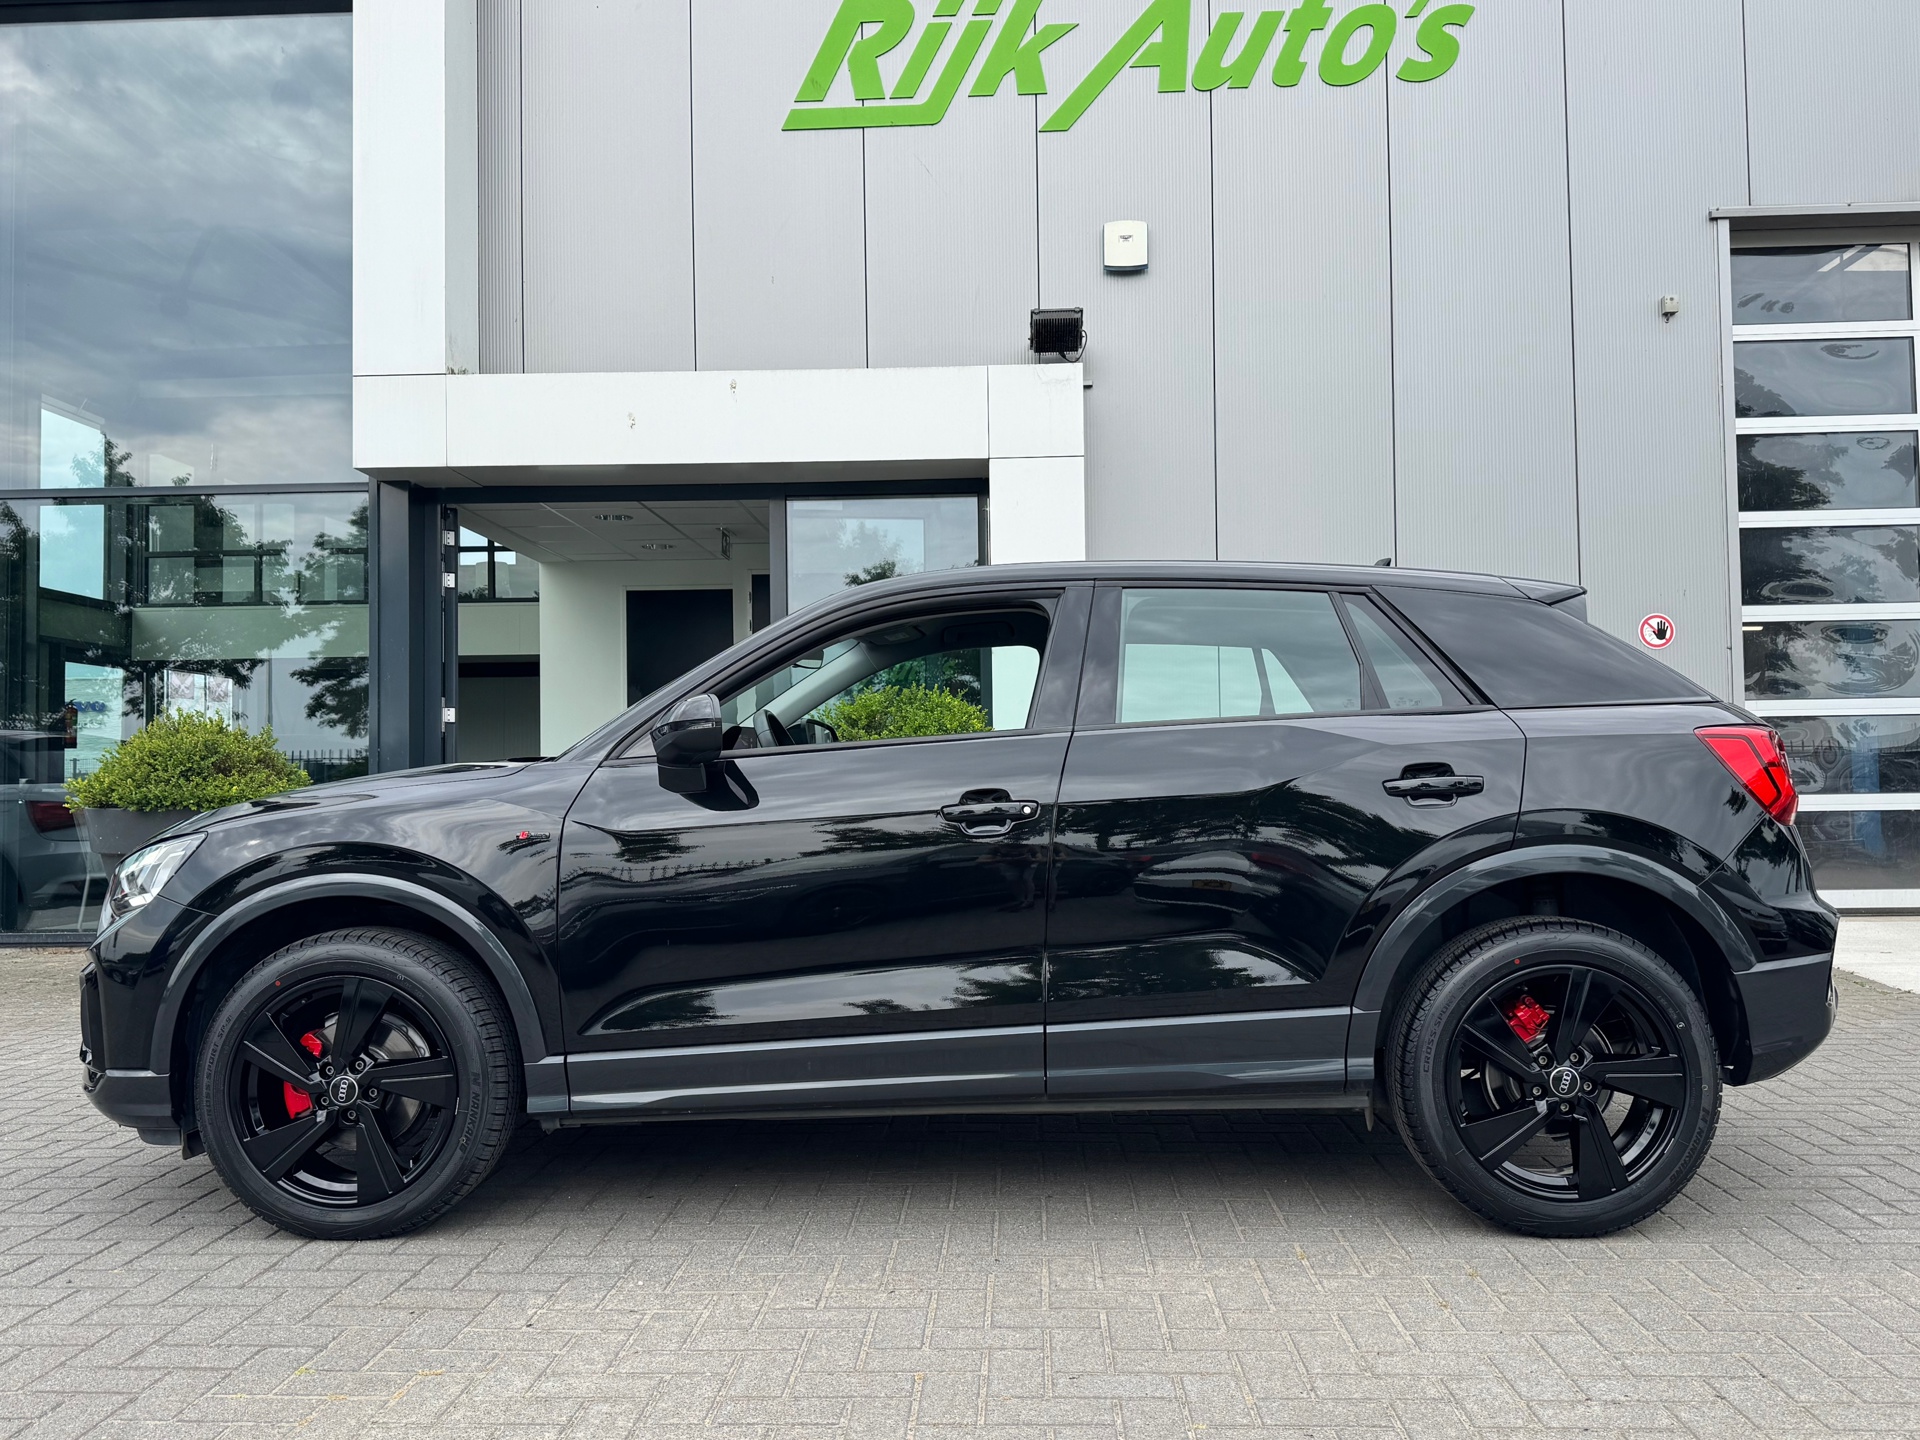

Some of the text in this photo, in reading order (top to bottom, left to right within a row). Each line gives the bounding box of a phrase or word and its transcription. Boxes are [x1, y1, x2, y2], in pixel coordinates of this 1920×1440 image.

[782, 0, 1079, 131] Rijk
[458, 1091, 480, 1154] NANKANG
[1669, 1126, 1705, 1184] NANKANG
